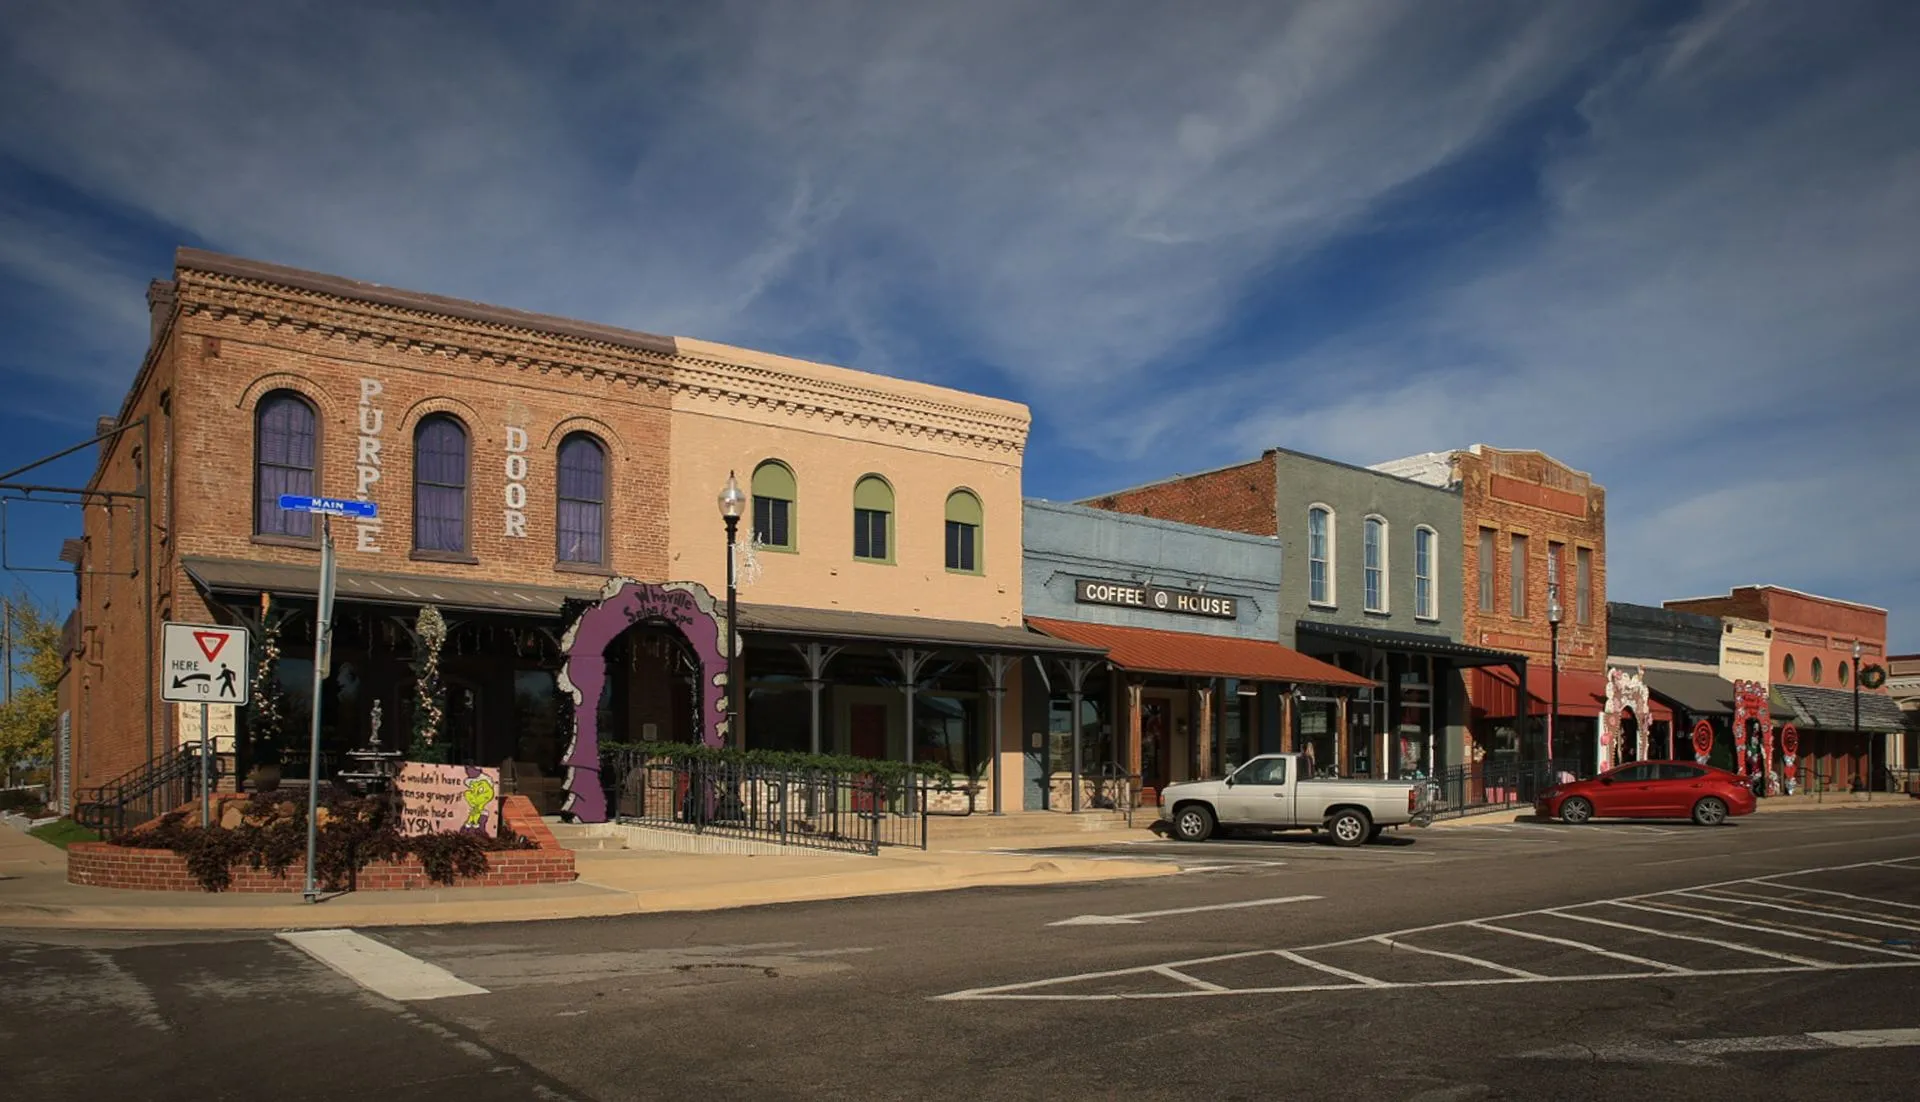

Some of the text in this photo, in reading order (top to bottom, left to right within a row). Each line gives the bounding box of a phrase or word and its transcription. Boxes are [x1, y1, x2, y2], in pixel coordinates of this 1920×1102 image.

[504, 425, 529, 537] DOOR
[634, 584, 693, 610] Whoville
[1086, 584, 1145, 605] COFFEE
[1177, 595, 1231, 615] HOUSE
[623, 605, 658, 623] Salon
[671, 606, 693, 625] Spa
[171, 659, 200, 671] HERE
[197, 683, 210, 694] TO
[441, 772, 462, 786] have
[431, 805, 448, 818] had
